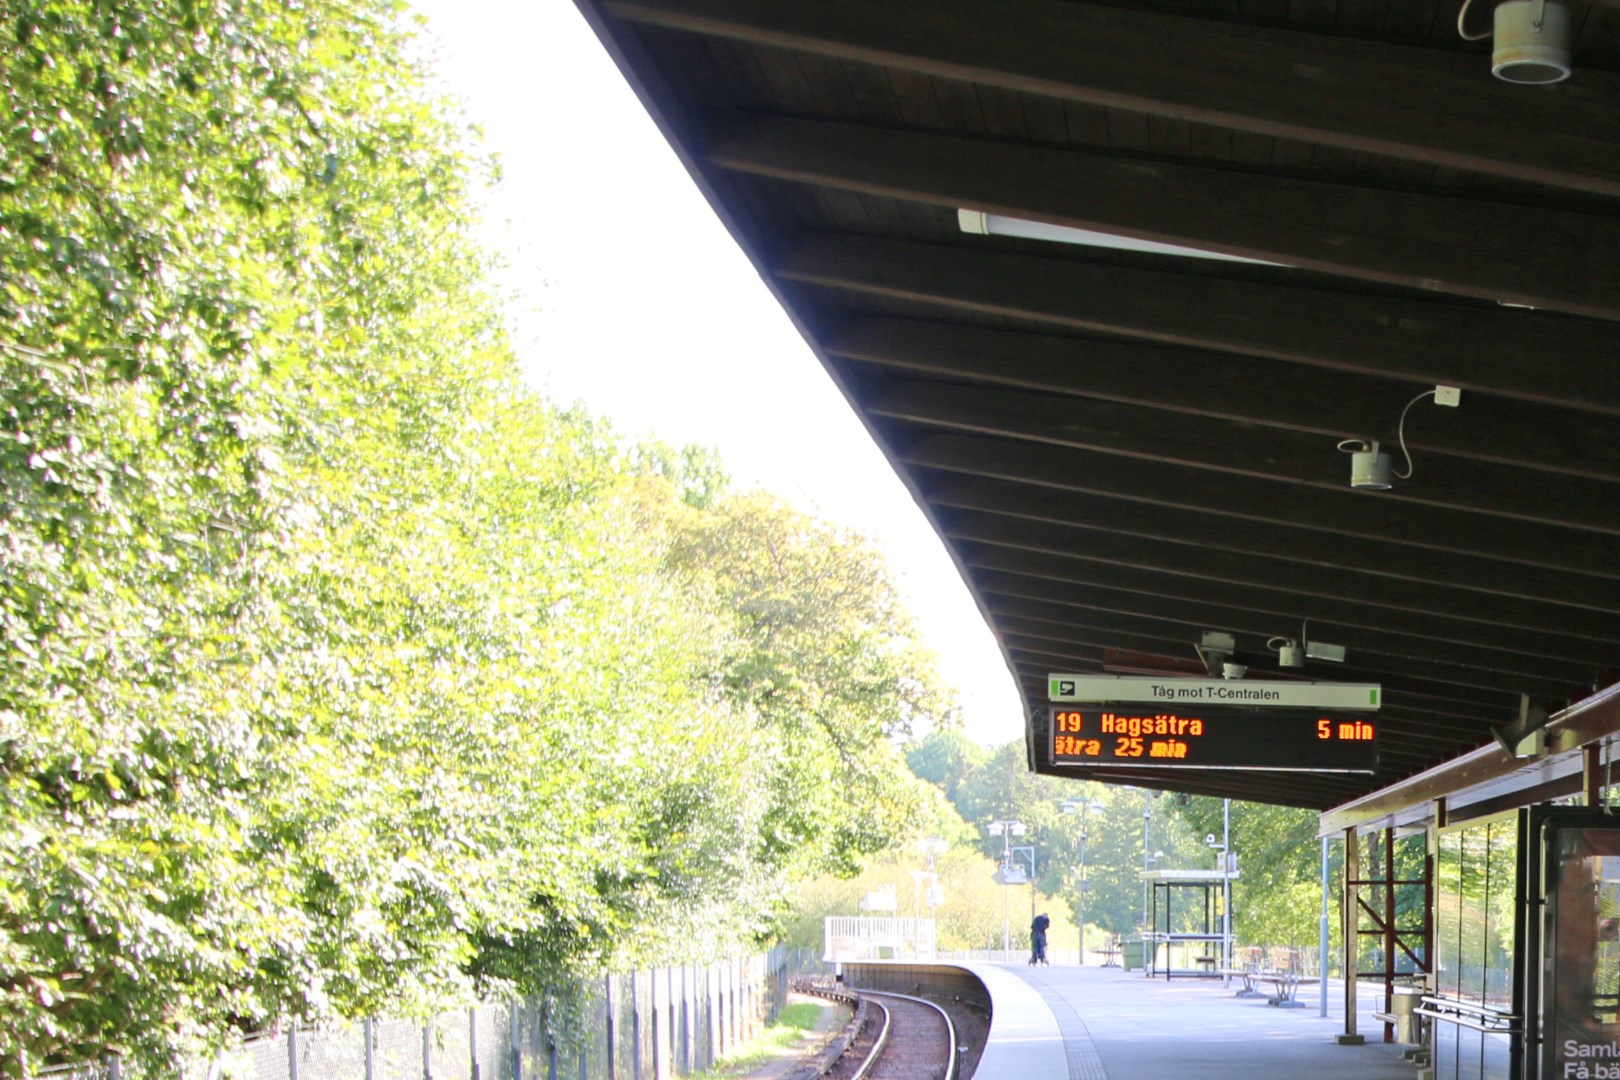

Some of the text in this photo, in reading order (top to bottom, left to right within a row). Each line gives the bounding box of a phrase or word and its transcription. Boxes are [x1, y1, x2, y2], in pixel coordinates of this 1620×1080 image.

[1151, 685, 1281, 700] Tåg mot T-Centralen
[1056, 712, 1203, 737] 19 Hagsätra
[1317, 719, 1374, 740] 5 min
[1054, 736, 1189, 758] ätra 25 min
[1563, 1061, 1589, 1080] Få
